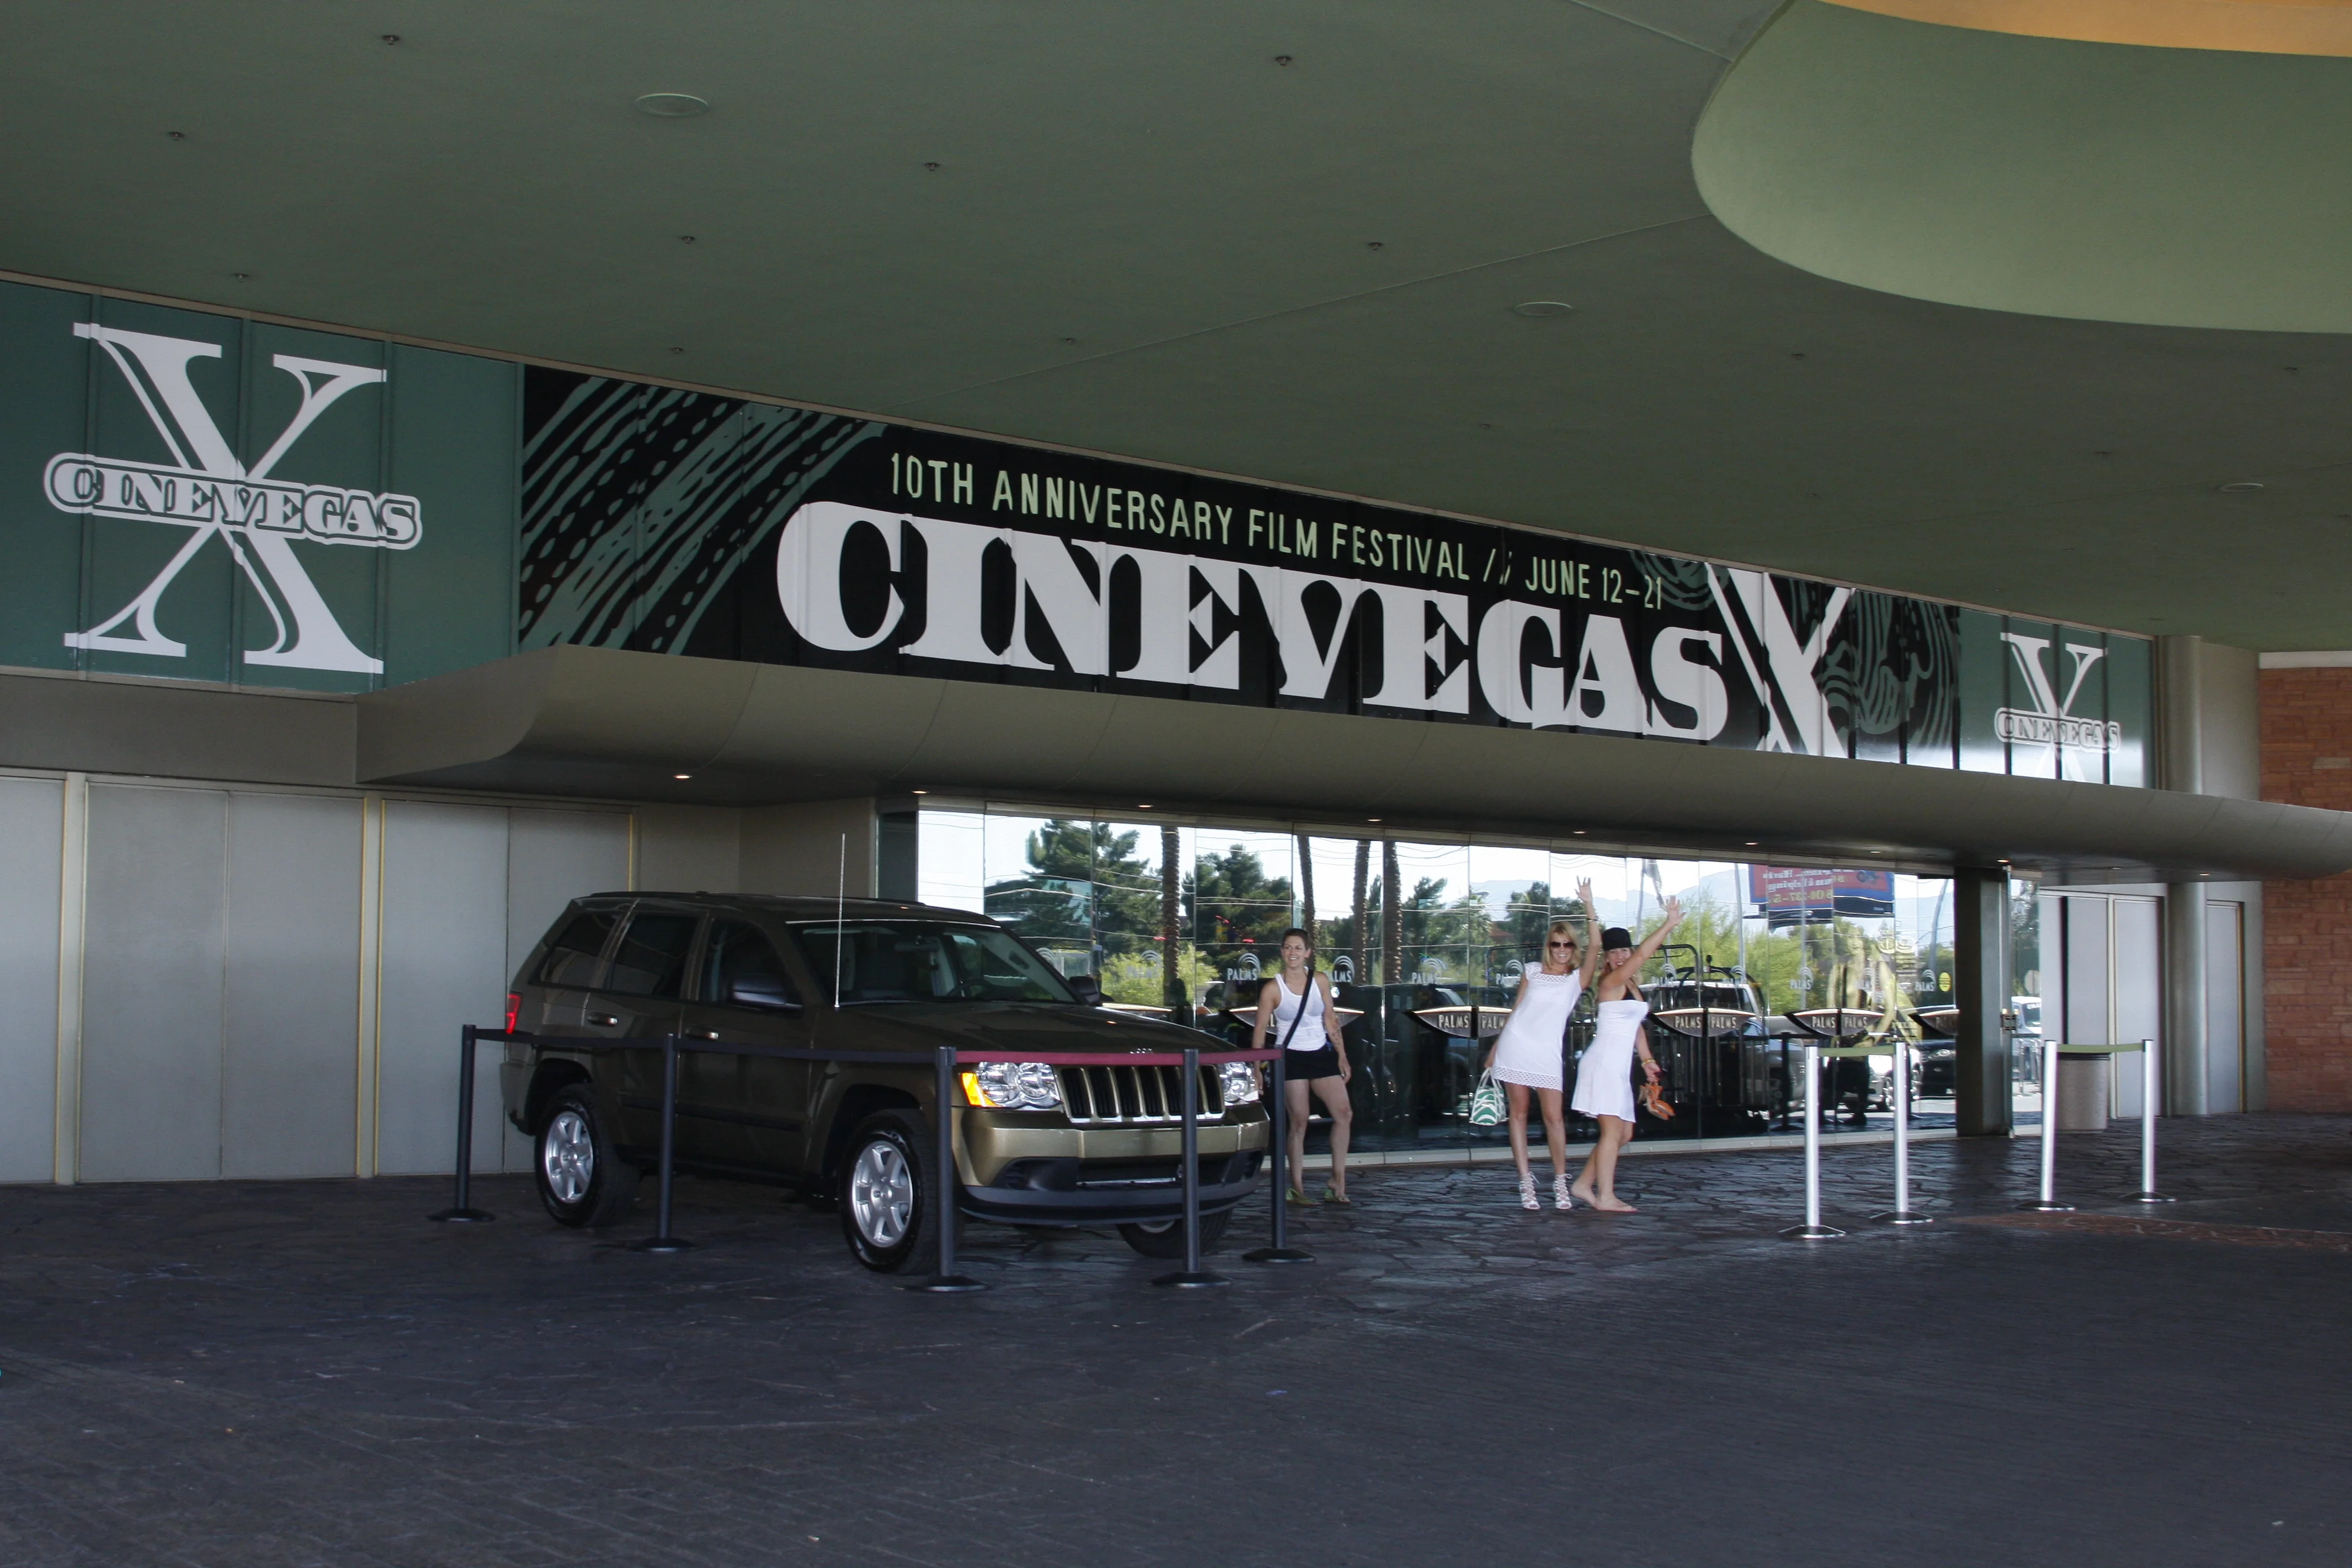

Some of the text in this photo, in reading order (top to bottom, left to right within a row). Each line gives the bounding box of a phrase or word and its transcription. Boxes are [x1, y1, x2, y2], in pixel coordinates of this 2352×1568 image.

[51, 459, 417, 543] CINEVEGAS
[64, 322, 387, 674] X
[891, 452, 973, 506] 10TH
[992, 470, 1233, 545] ANNIVERSARY
[1249, 509, 1317, 559] FILM
[1332, 522, 1470, 581] FESTIVAL
[1525, 556, 1590, 599] JUNE
[777, 500, 1857, 759] CINEVEGAS X
[1227, 968, 1258, 981] PALMS
[1412, 972, 1438, 985] PALMS
[1915, 981, 1935, 991] PALMS
[1438, 1014, 1469, 1028] PALMS
[1483, 1015, 1506, 1029] PALM
[1674, 1016, 1702, 1029] PALMS
[1812, 1016, 1836, 1028] PALMS
